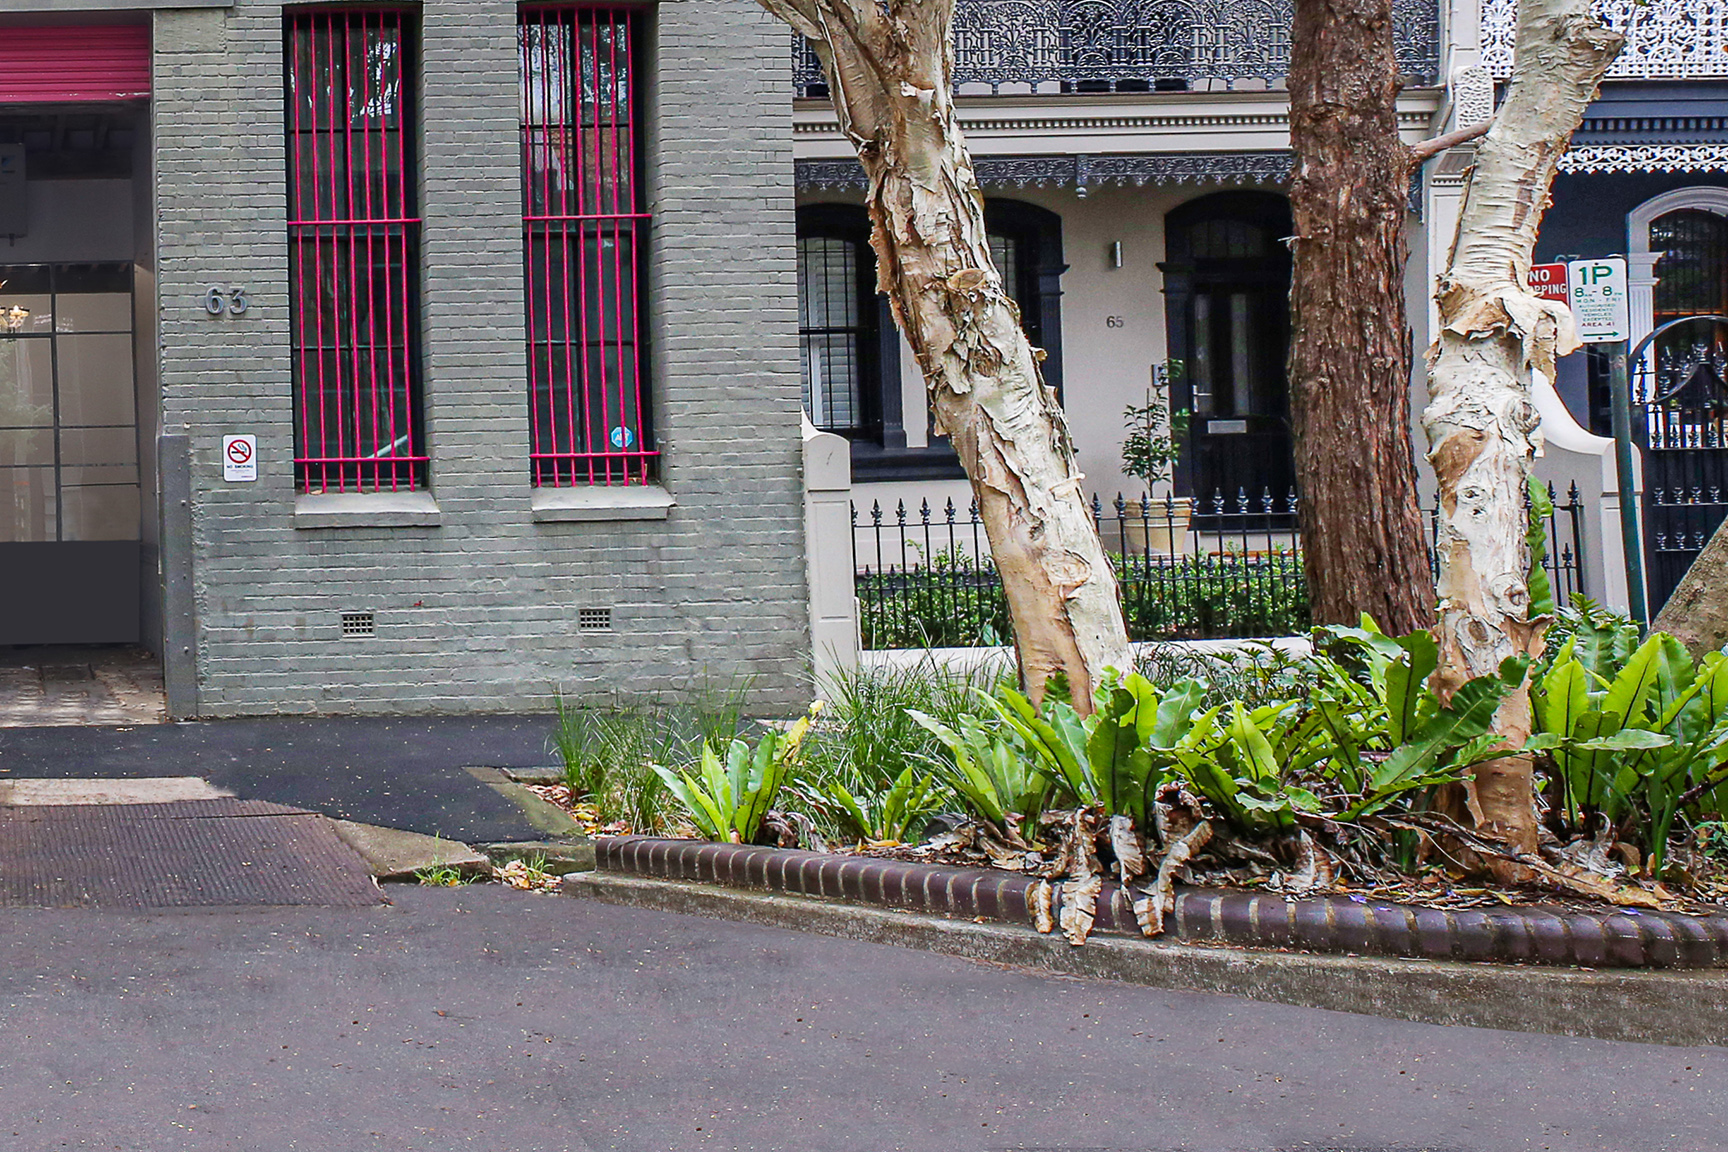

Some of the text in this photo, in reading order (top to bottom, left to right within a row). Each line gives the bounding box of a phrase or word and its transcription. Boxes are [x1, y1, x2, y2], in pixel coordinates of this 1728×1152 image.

[1529, 269, 1550, 282] NO
[1579, 266, 1613, 285] 1P
[205, 286, 248, 315] 63
[1106, 315, 1124, 329] 65
